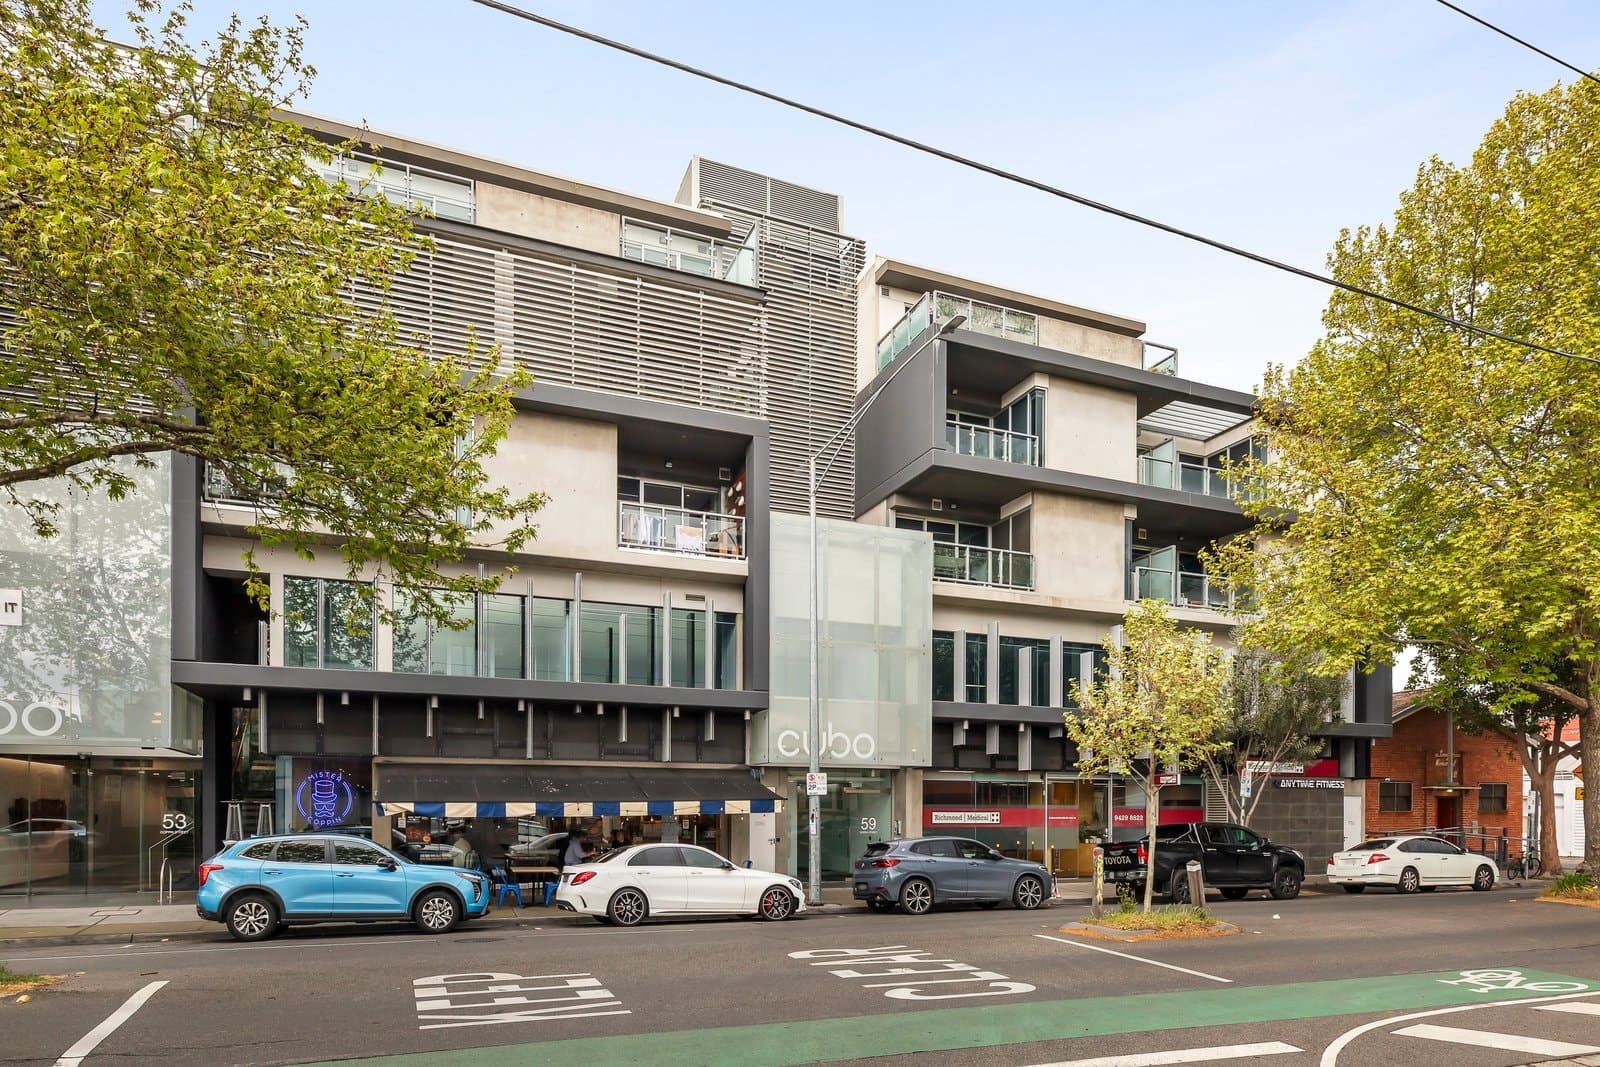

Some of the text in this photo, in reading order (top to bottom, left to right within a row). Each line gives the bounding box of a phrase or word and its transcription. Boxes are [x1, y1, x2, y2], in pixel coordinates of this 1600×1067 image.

[777, 722, 875, 758] cubo
[307, 771, 342, 783] MISTER
[1280, 780, 1345, 789] ANYTIME FITNESS
[162, 813, 187, 829] 53
[307, 816, 342, 826] COPPIN
[934, 813, 989, 821] Richmond Medical
[860, 817, 877, 830] 59
[1104, 856, 1131, 865] TOYOTA
[787, 945, 1037, 1000] CLEAR
[413, 972, 632, 1030] KEEP
